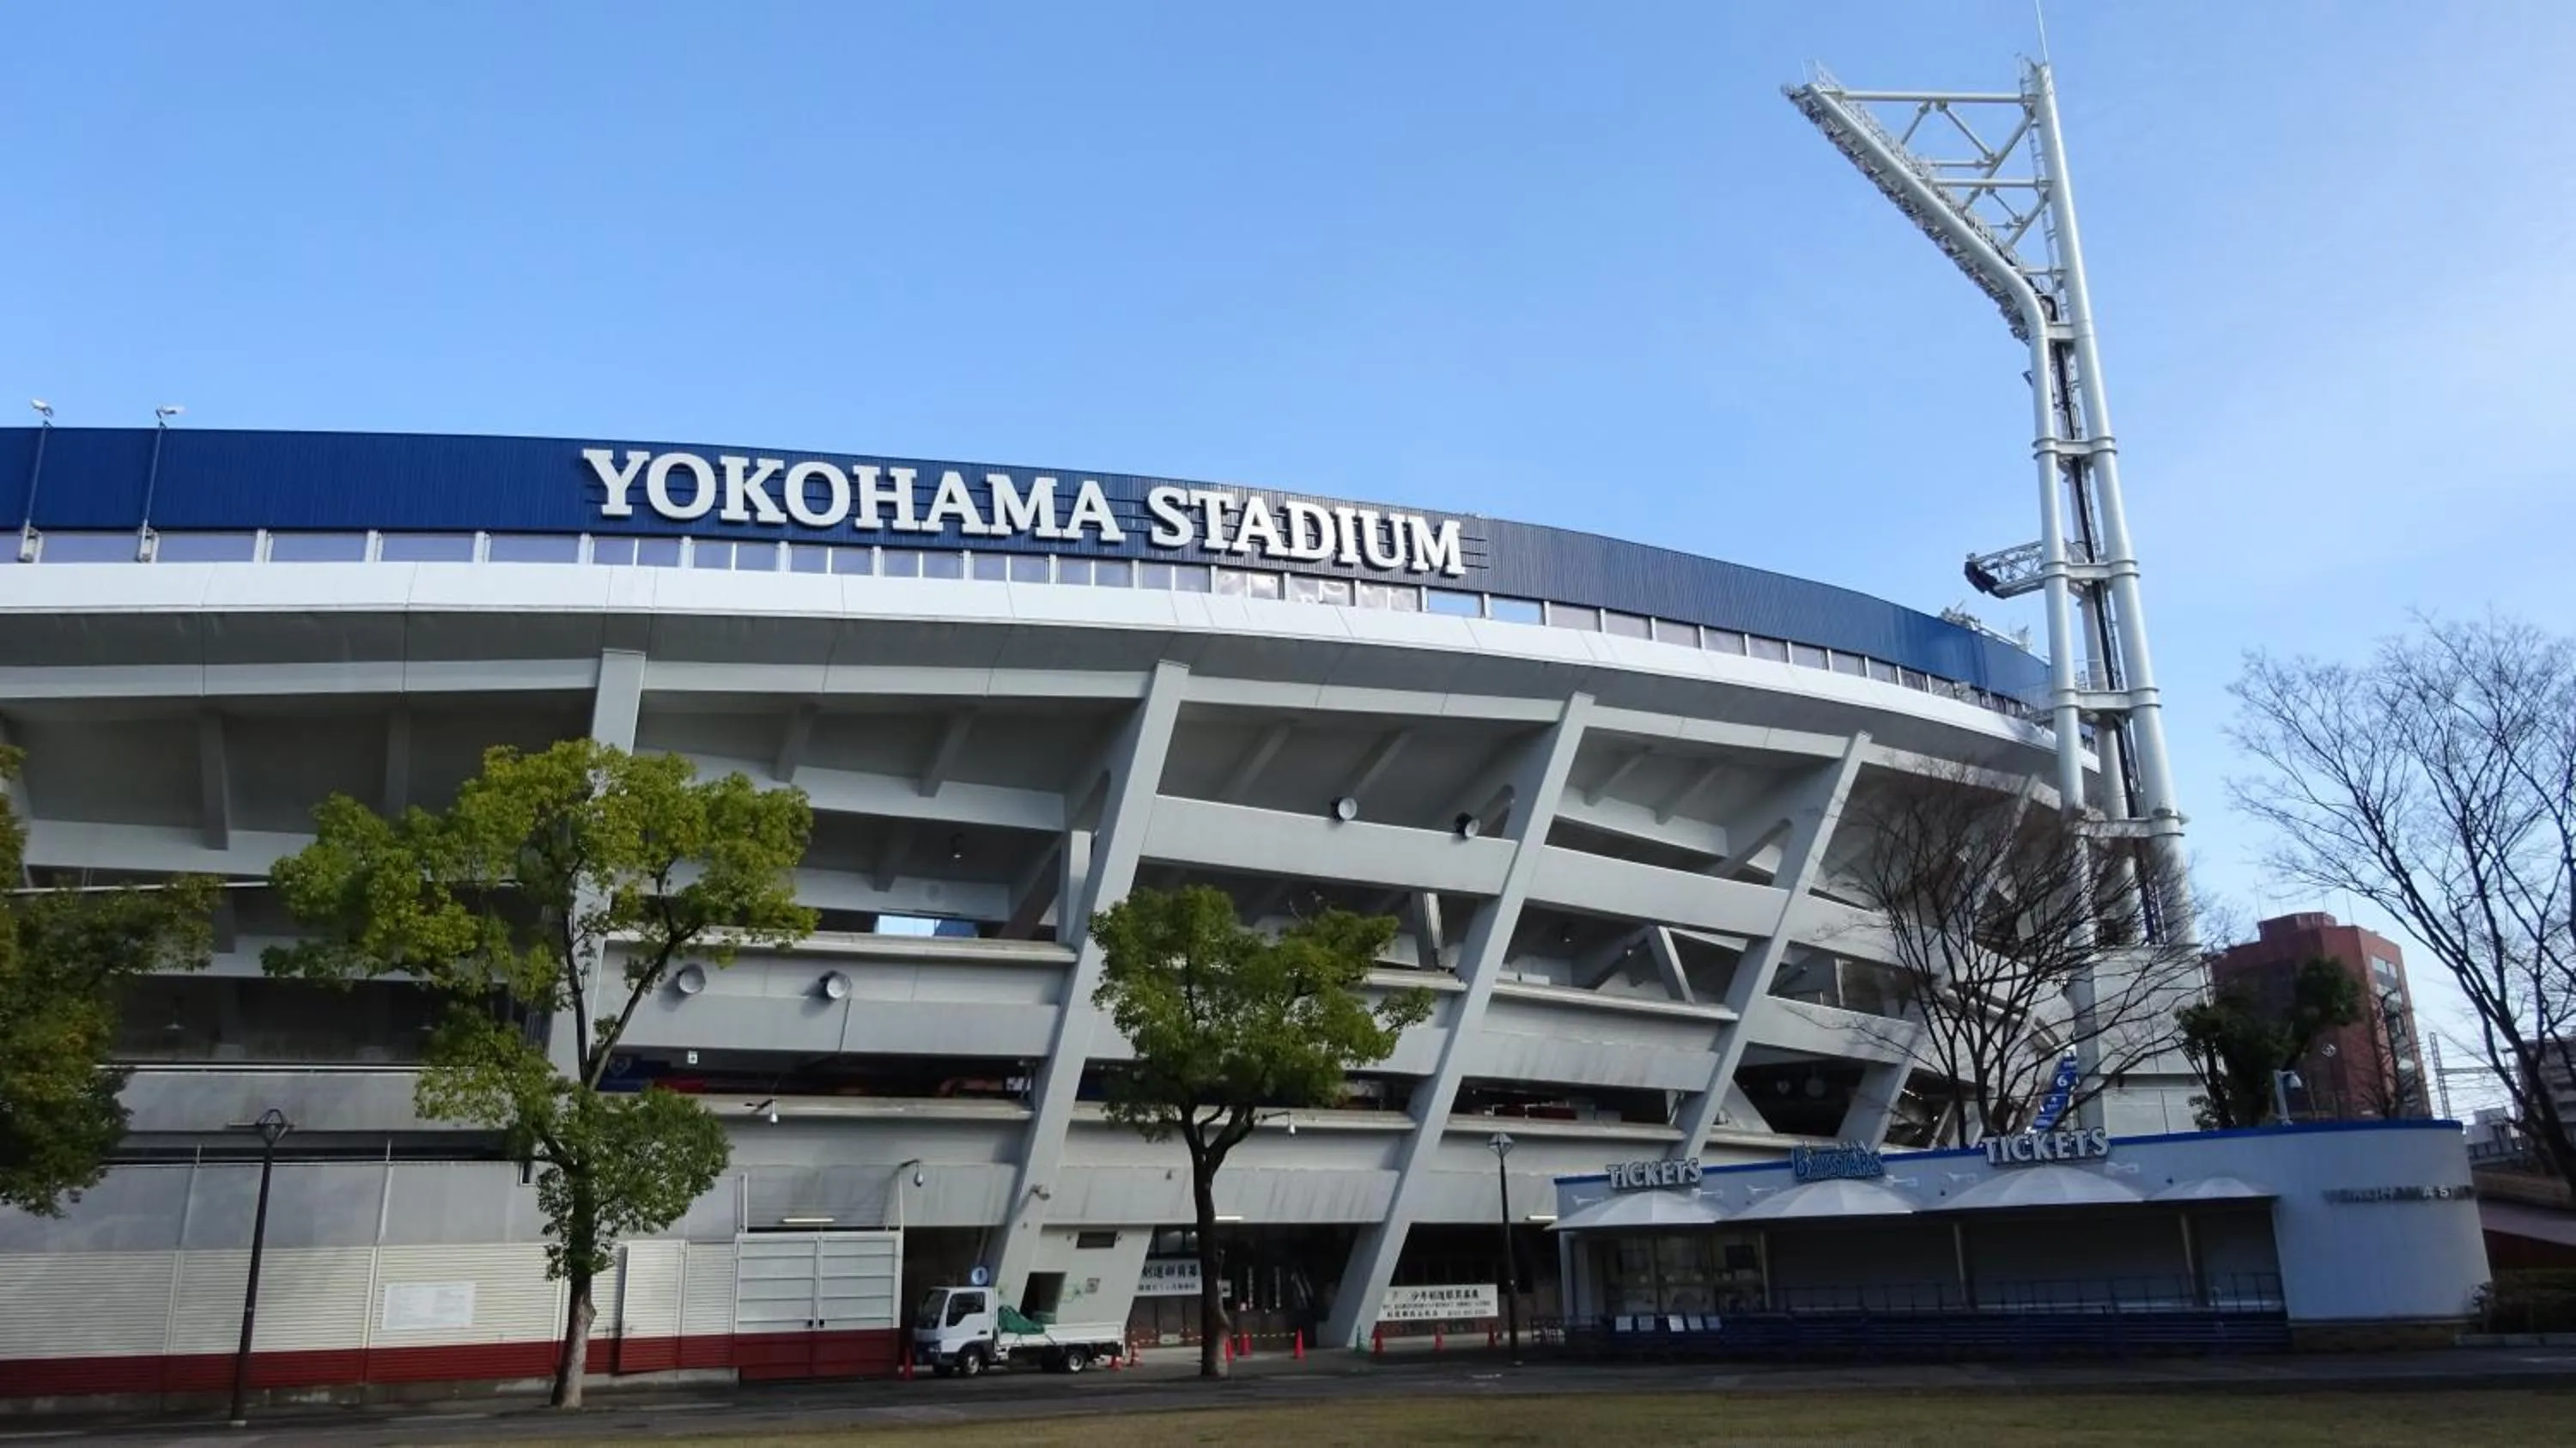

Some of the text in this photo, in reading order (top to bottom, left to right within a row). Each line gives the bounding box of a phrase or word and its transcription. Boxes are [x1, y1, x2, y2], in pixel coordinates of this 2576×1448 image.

[583, 448, 1466, 575] YOKOHAMA STADIUM
[1981, 1126, 2109, 1162] TICKETS
[1606, 1157, 1702, 1188] TICKETS
